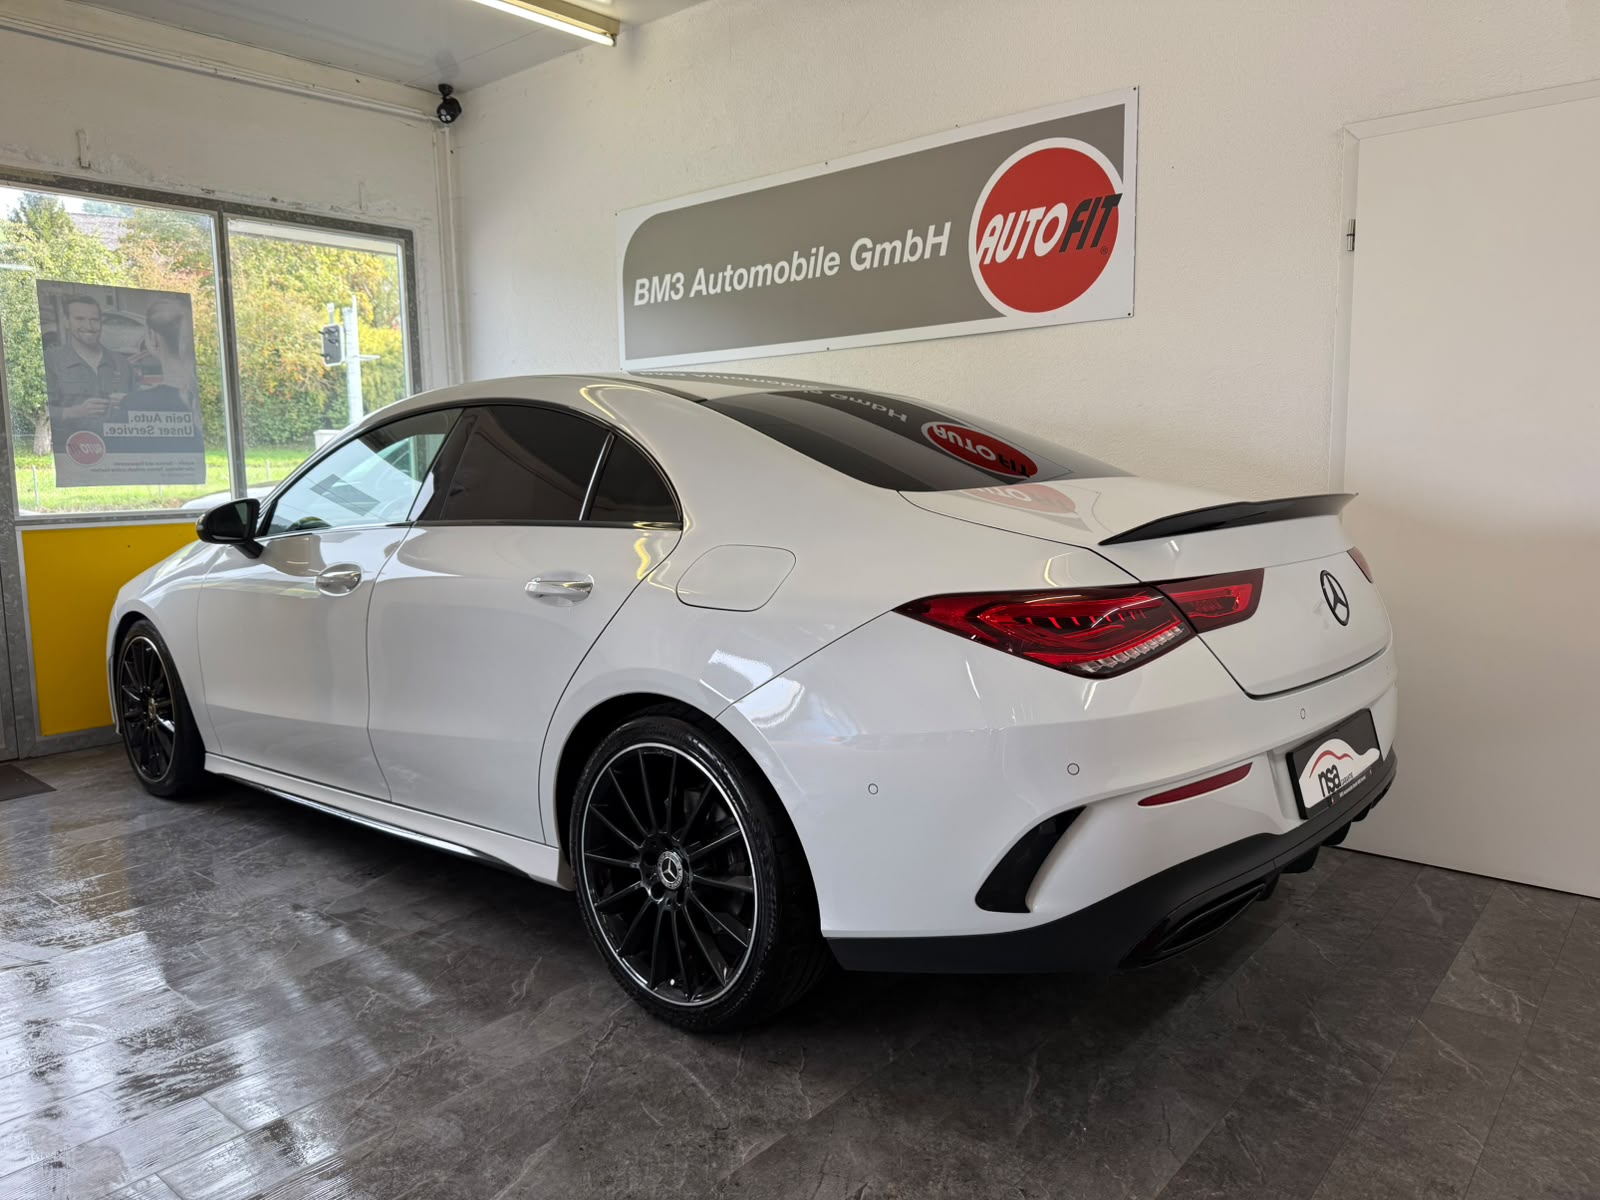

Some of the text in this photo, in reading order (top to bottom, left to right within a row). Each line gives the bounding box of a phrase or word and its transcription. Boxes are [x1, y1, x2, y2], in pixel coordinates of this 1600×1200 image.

[634, 221, 951, 306] BM3 Automobile GmbH
[975, 193, 1123, 265] AUTOFIT
[1317, 764, 1342, 798] nsa
